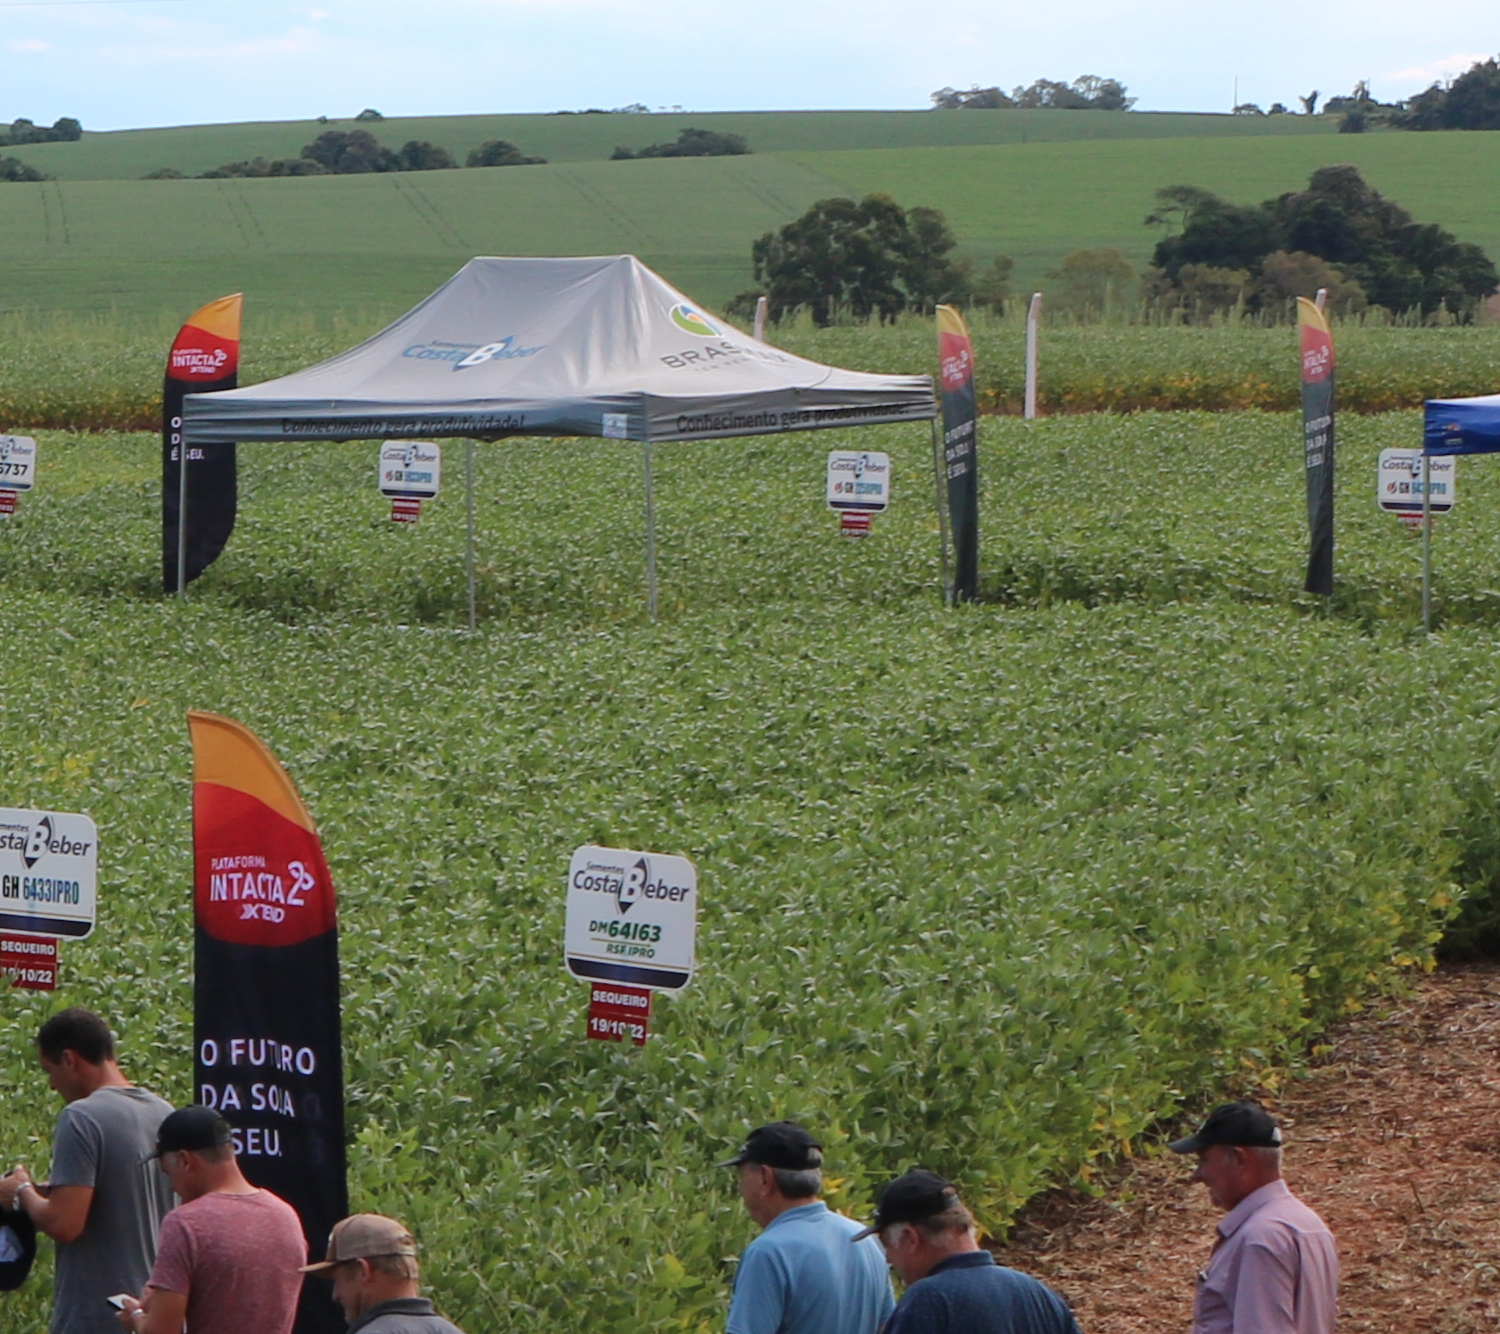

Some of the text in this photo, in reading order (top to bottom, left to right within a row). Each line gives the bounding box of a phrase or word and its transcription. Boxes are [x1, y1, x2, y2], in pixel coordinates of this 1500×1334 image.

[402, 340, 547, 368] CostaBeber
[171, 417, 181, 428] O
[281, 415, 525, 436] Conhecimento gera produtividade!
[676, 411, 777, 433] Conhecimento
[171, 447, 178, 461] É
[211, 855, 265, 870] PLATAFORMA
[586, 861, 624, 874] Sementes
[2, 874, 79, 905] GH 6433IPRO
[573, 865, 690, 905] CostaBeber
[1, 941, 55, 955] SEQUEIRO
[606, 944, 655, 959] RSF IPRO
[592, 990, 648, 1008] SEQUEIRO
[200, 1038, 218, 1067] O
[201, 1083, 241, 1110] DA
[231, 1127, 283, 1157] SEU.
